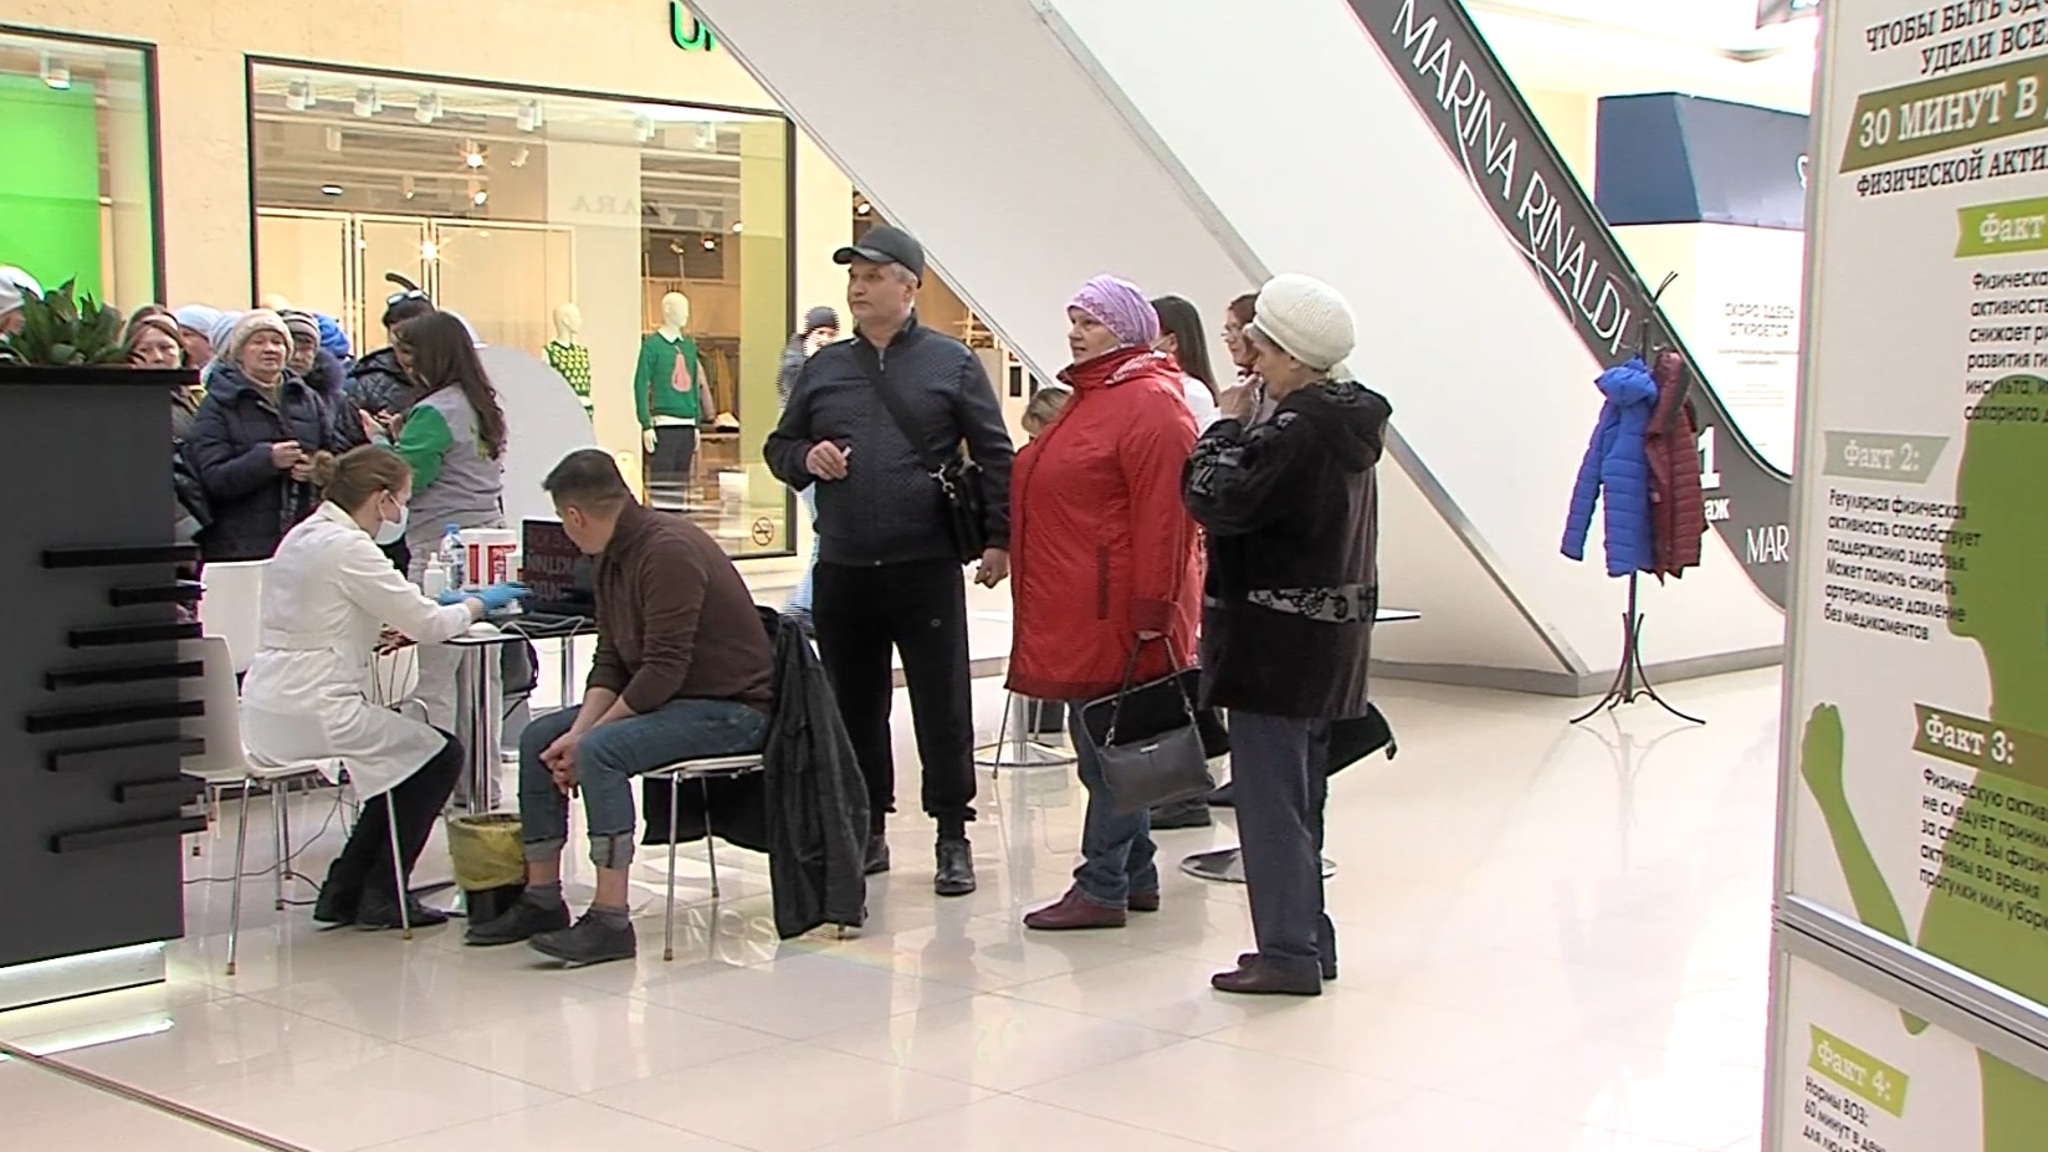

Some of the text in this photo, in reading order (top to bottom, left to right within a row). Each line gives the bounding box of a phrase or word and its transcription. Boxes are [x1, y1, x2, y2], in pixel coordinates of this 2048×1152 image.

[1866, 10, 1936, 51] ЧТОБЫ
[1941, 0, 2002, 33] БЫТЬ
[1921, 18, 2048, 75] УДЕЛИ ВСЕ
[1859, 75, 2038, 148] 30 МИНУТ В
[1392, 0, 1632, 356] MARINA RINALDI
[1857, 148, 1984, 197] ФИЗИЧЕСКОЙ
[1988, 145, 2048, 178] АКТИ
[1980, 212, 2046, 244] Факт
[1969, 326, 2032, 342] снижает
[1966, 353, 2030, 373] развития
[1964, 405, 2039, 424] сахарного
[1844, 440, 1920, 472] Факт 2:
[1704, 499, 1730, 520] аж
[1829, 488, 1967, 520] Регулярная физическая
[1828, 514, 1982, 549] активность способствует
[1827, 538, 1968, 573] поддержанию здоровья.
[1826, 558, 1957, 596] Может помочь снизить
[1824, 603, 1930, 640] без медикаментов
[1825, 584, 1966, 623] артериальное давление
[1925, 713, 2014, 765] Факт 3:
[1923, 768, 2002, 808] Физическую
[1922, 796, 1938, 812] не
[1941, 801, 1995, 831] следует
[1921, 820, 1936, 836] за
[1938, 825, 1980, 852] спорт.
[1984, 837, 2003, 858] Вы
[1920, 845, 2040, 899] активны во время
[1920, 868, 1978, 902] прогулки
[1980, 892, 2004, 912] или
[1817, 1040, 1892, 1101] Факт 4:
[1805, 1076, 1869, 1128] Нормы ВОЗ:
[1803, 1125, 1821, 1145] для
[1804, 1099, 1817, 1118] 60
[1818, 1110, 1851, 1139] минут
[1852, 1131, 1860, 1145] в
